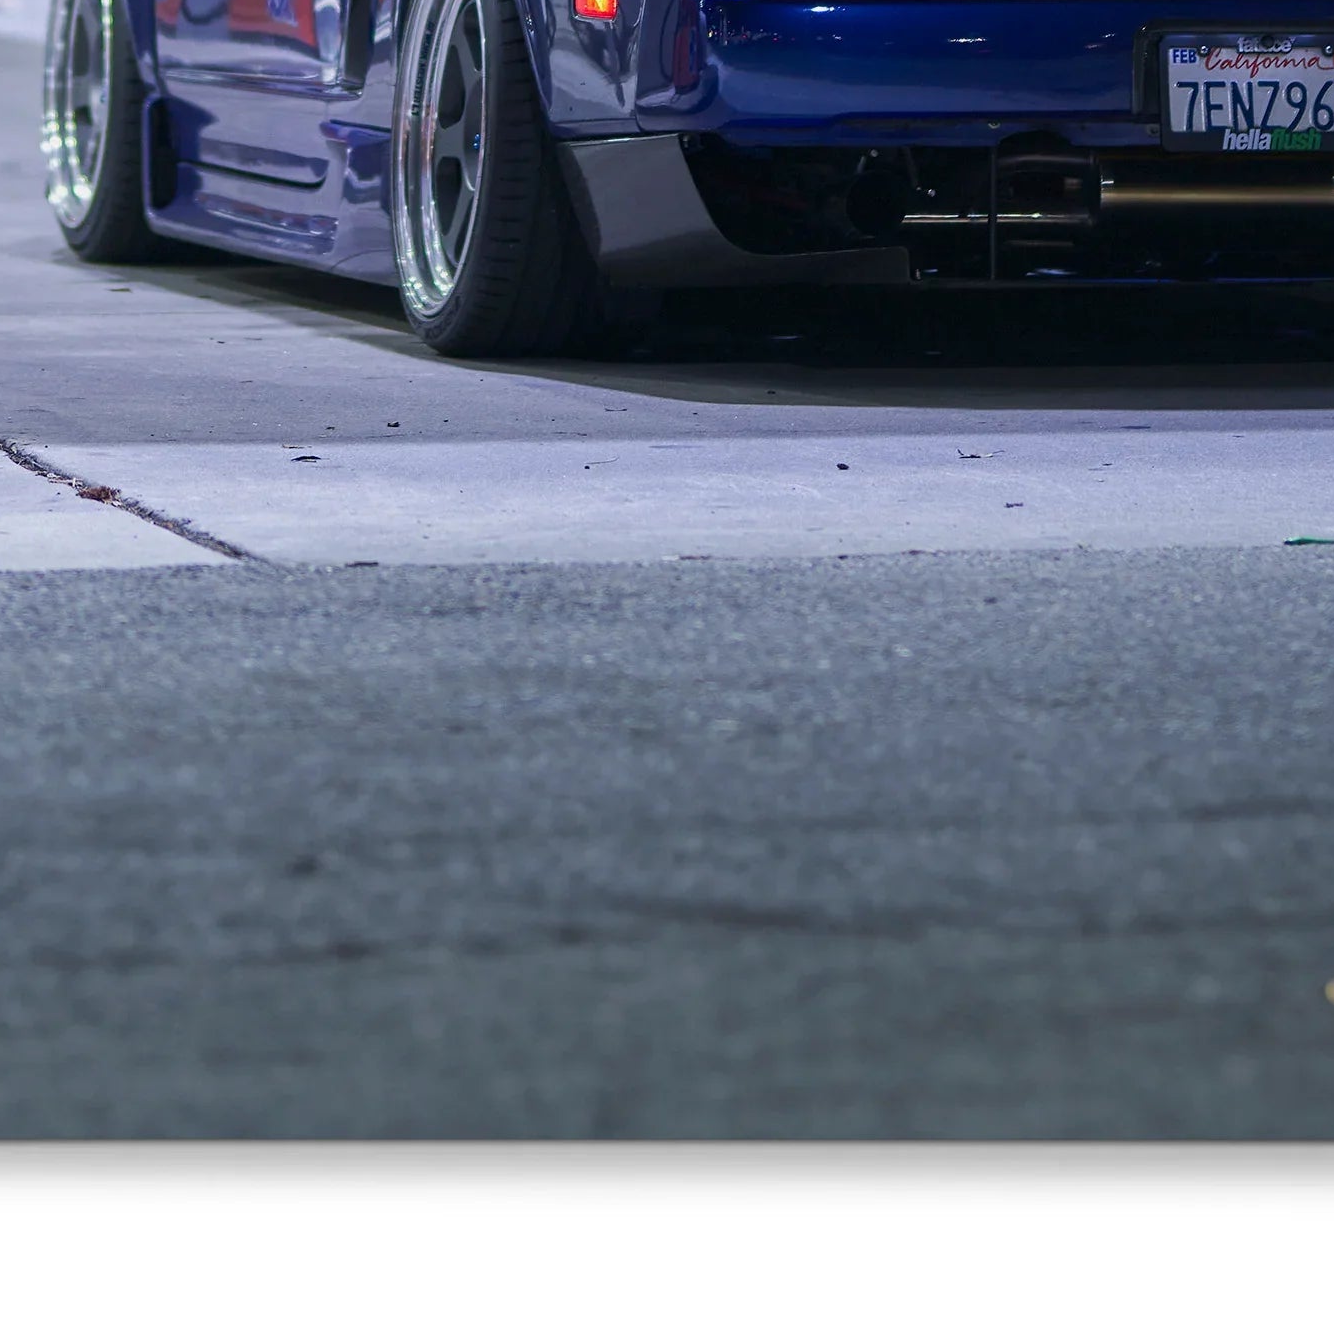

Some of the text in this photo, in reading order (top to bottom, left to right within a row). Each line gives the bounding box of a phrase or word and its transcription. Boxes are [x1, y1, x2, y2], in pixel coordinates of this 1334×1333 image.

[1172, 49, 1197, 64] FEB
[1204, 47, 1334, 78] California
[1222, 128, 1322, 151] hellaflush
